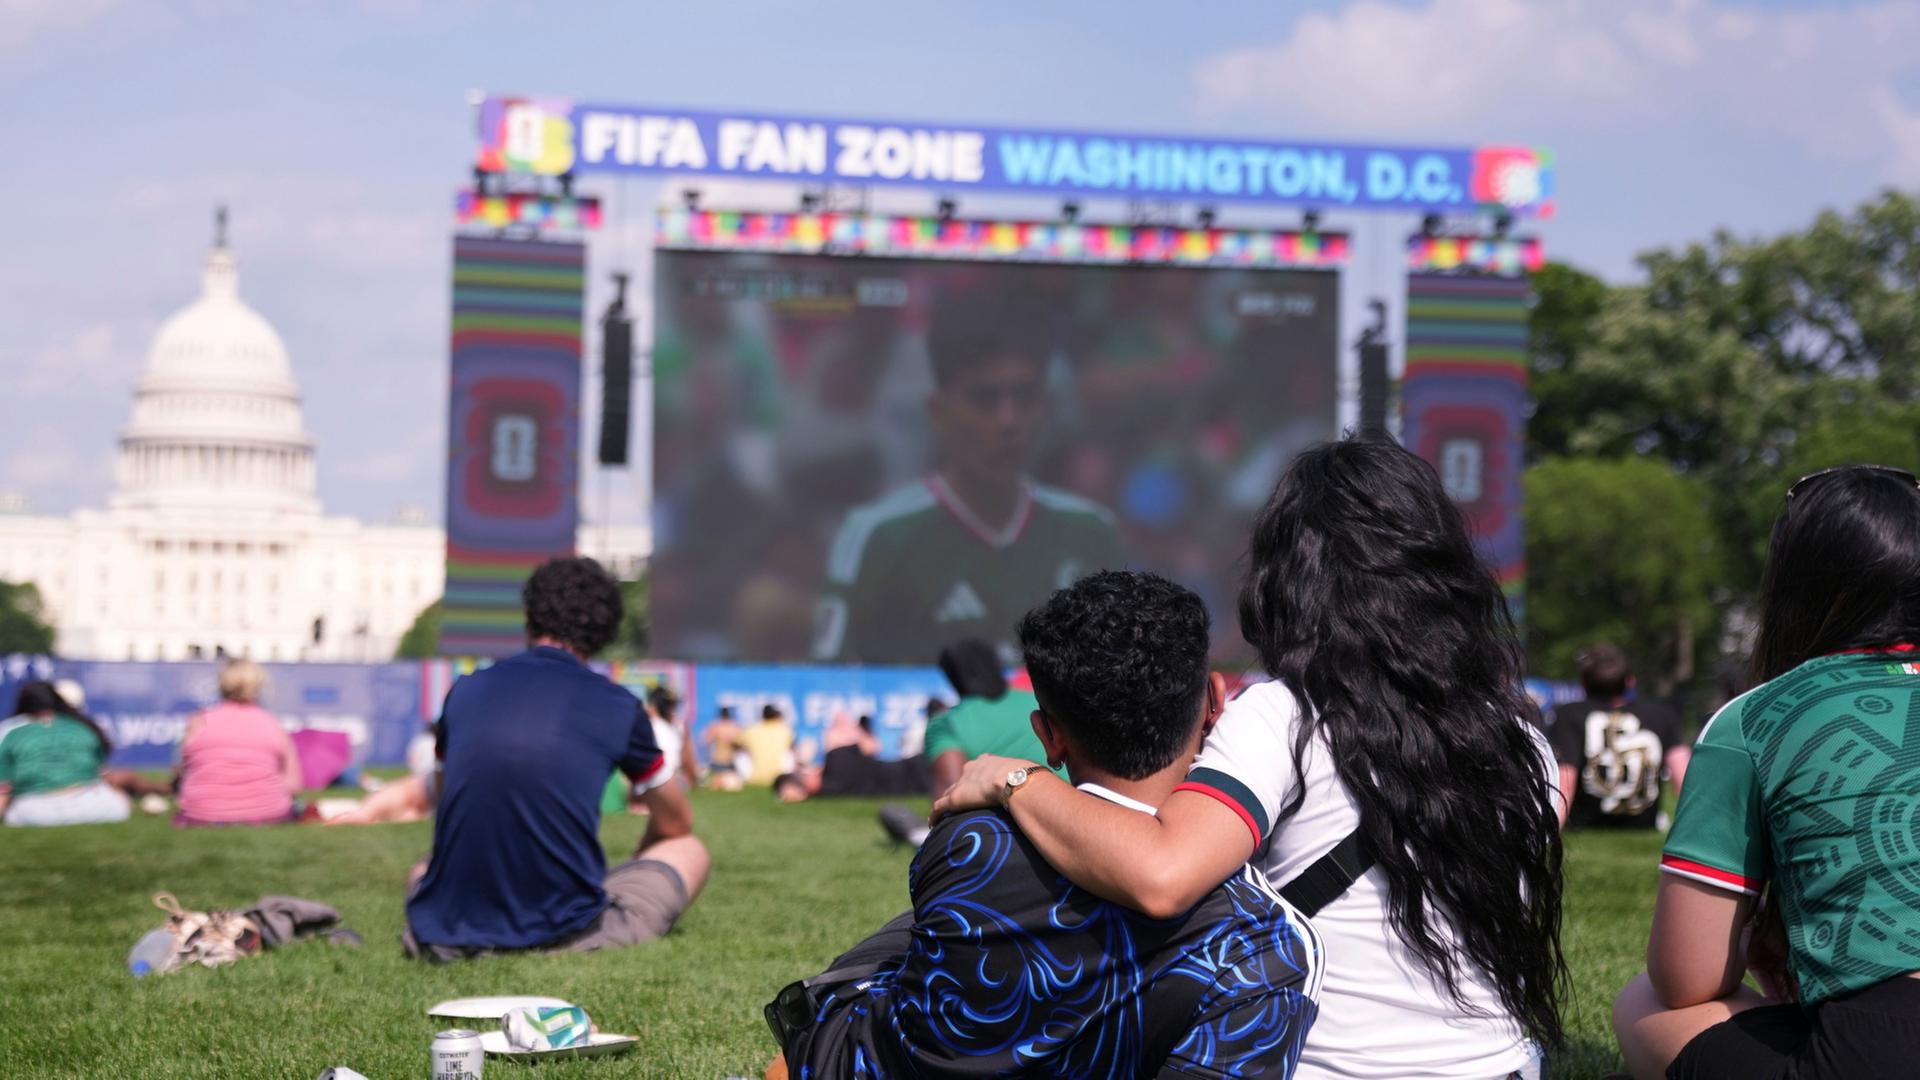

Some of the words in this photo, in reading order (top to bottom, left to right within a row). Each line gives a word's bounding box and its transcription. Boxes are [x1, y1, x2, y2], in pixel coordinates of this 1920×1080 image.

[582, 112, 708, 169] FIFA
[718, 118, 828, 174] FAN
[834, 125, 985, 182] ZONE
[999, 134, 1357, 204] WASHINGTON,
[1366, 153, 1463, 202] D.C.
[445, 1061, 462, 1072] LIME
